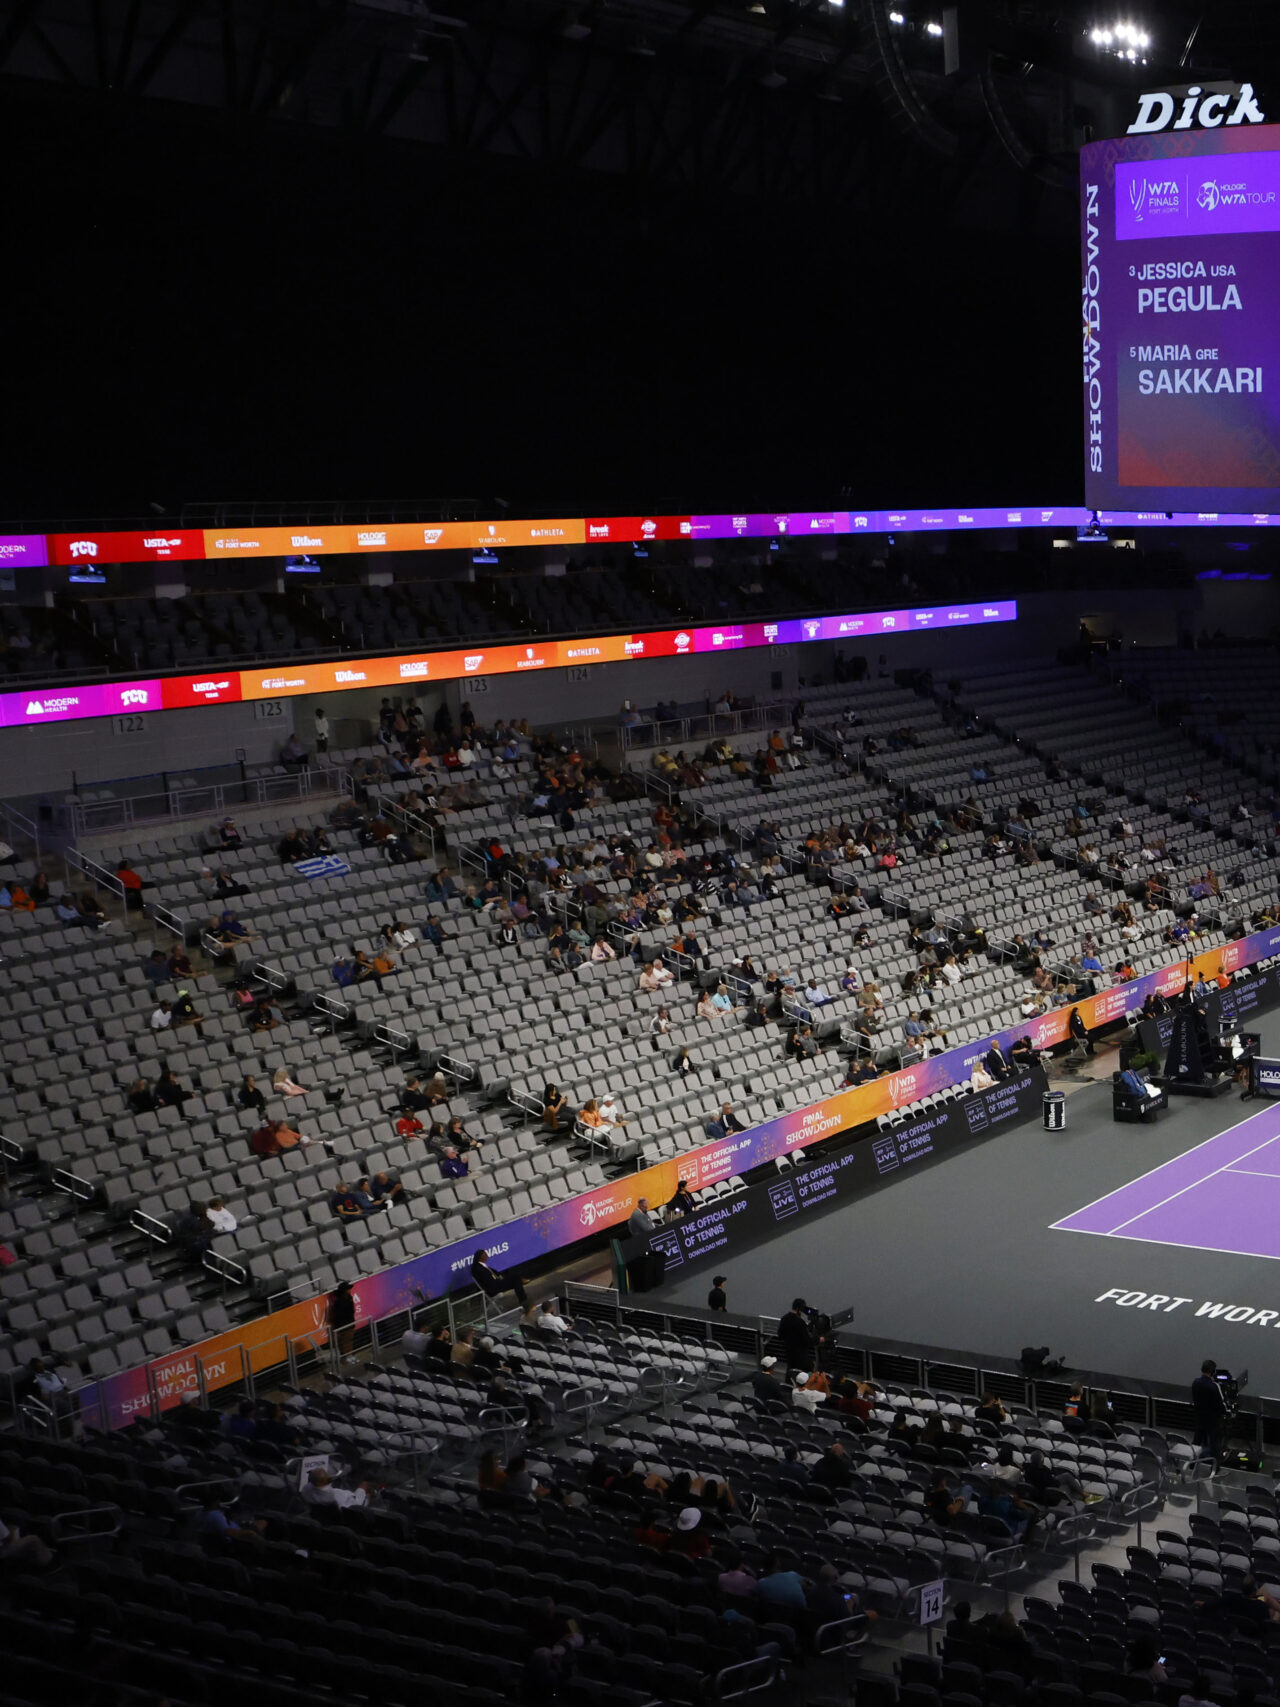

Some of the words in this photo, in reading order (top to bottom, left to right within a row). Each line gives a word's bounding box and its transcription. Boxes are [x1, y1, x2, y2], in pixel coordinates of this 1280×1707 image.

[1148, 182, 1179, 196] WTA
[1220, 183, 1246, 191] HOLOGIC
[1149, 196, 1179, 207] FINALS
[1129, 266, 1135, 277] 3
[1137, 261, 1207, 281] JESSICA
[1210, 264, 1236, 277] USA
[1138, 284, 1243, 314] PEGULA
[1086, 184, 1102, 472] SHOWDOWN
[1129, 346, 1136, 358] 5
[1138, 344, 1192, 362] MARIA
[1195, 349, 1218, 361] GRE
[1138, 367, 1263, 395] SAKKARI
[536, 529, 564, 537] ATHLETA
[69, 541, 98, 557] TCU
[572, 648, 600, 657] ATHLETA
[624, 640, 644, 650] break
[570, 668, 588, 681] 124
[468, 678, 488, 692] 123
[44, 697, 79, 706] MODERN
[121, 689, 148, 706] TCU
[259, 702, 283, 716] 123
[119, 715, 144, 732] 122
[900, 1074, 916, 1087] WTA
[985, 1092, 996, 1104] THE
[996, 1084, 1021, 1101] OFFICIAL
[1021, 1078, 1032, 1090] APP
[988, 1104, 998, 1114] OF
[998, 1096, 1017, 1110] TENNIS
[802, 1110, 825, 1125] FINAL
[968, 1111, 986, 1123] LIVE
[785, 1114, 842, 1145] SHOWDOWN
[896, 1130, 908, 1143] THE
[908, 1121, 936, 1139] OFFICIAL
[936, 1113, 949, 1125] APP
[701, 1152, 713, 1164] THE
[713, 1144, 738, 1159] OFFICIAL
[739, 1139, 752, 1150] APP
[899, 1142, 909, 1153] OF
[909, 1133, 931, 1149] TENNIS
[702, 1164, 709, 1173] OF
[710, 1156, 732, 1169] TENNIS
[877, 1150, 897, 1163] LIVE
[795, 1173, 809, 1185] THE
[809, 1162, 840, 1180] OFFICIAL
[840, 1154, 854, 1167] APP
[799, 1186, 809, 1197] OF
[809, 1175, 834, 1192] TENNIS
[773, 1195, 794, 1209] LIVE
[680, 1222, 697, 1236] THE
[696, 1209, 731, 1228] OFFICIAL
[732, 1200, 747, 1215] APP
[684, 1236, 695, 1247] OF
[696, 1223, 725, 1242] TENNIS
[451, 1242, 509, 1272] #WTALS
[687, 1242, 716, 1259] DOWNLOAD
[716, 1237, 728, 1246] NOW
[1094, 1288, 1193, 1312] FORT
[121, 1361, 226, 1414] SHWDOWN
[926, 1596, 939, 1618] 14
